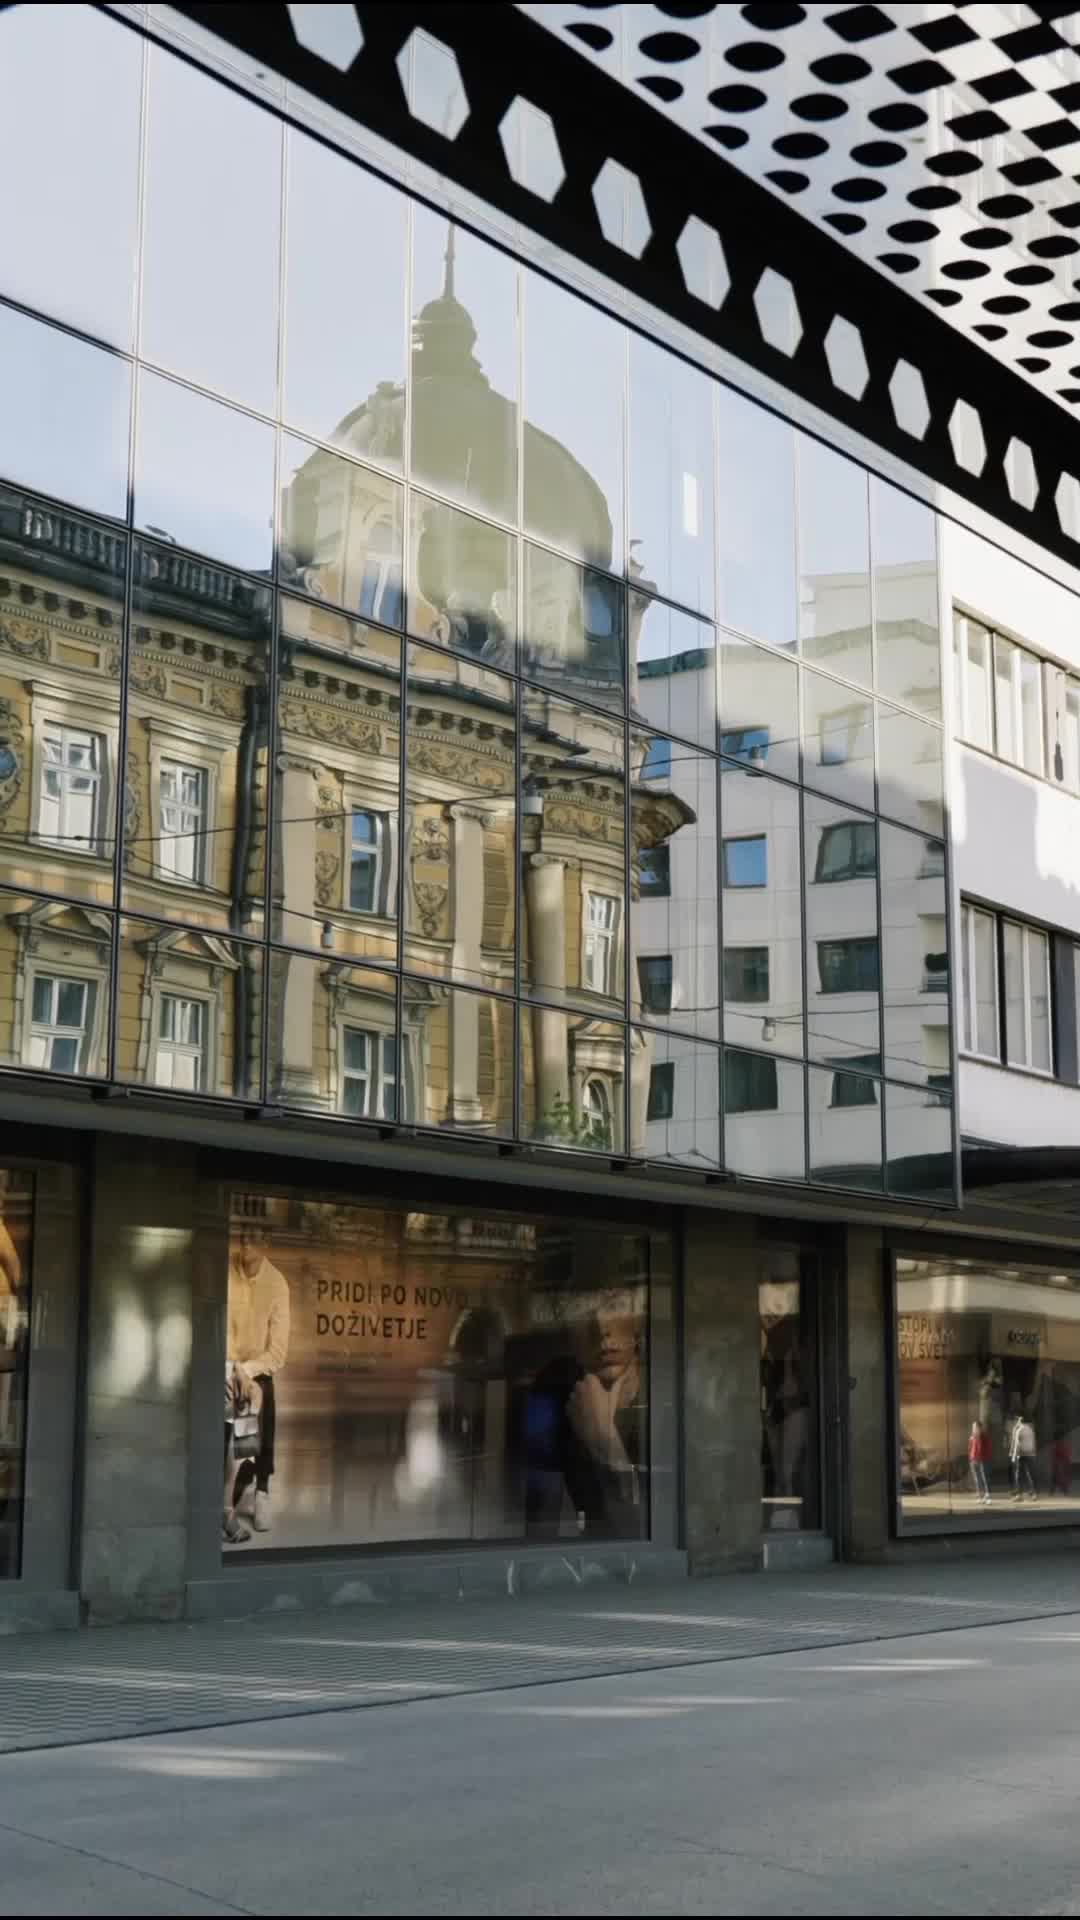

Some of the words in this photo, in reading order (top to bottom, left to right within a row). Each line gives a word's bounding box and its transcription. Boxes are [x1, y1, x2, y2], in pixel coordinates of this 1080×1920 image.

[317, 1280, 372, 1304] PRIDI
[381, 1284, 406, 1305] PO
[316, 1310, 427, 1339] DOŽIVETJE
